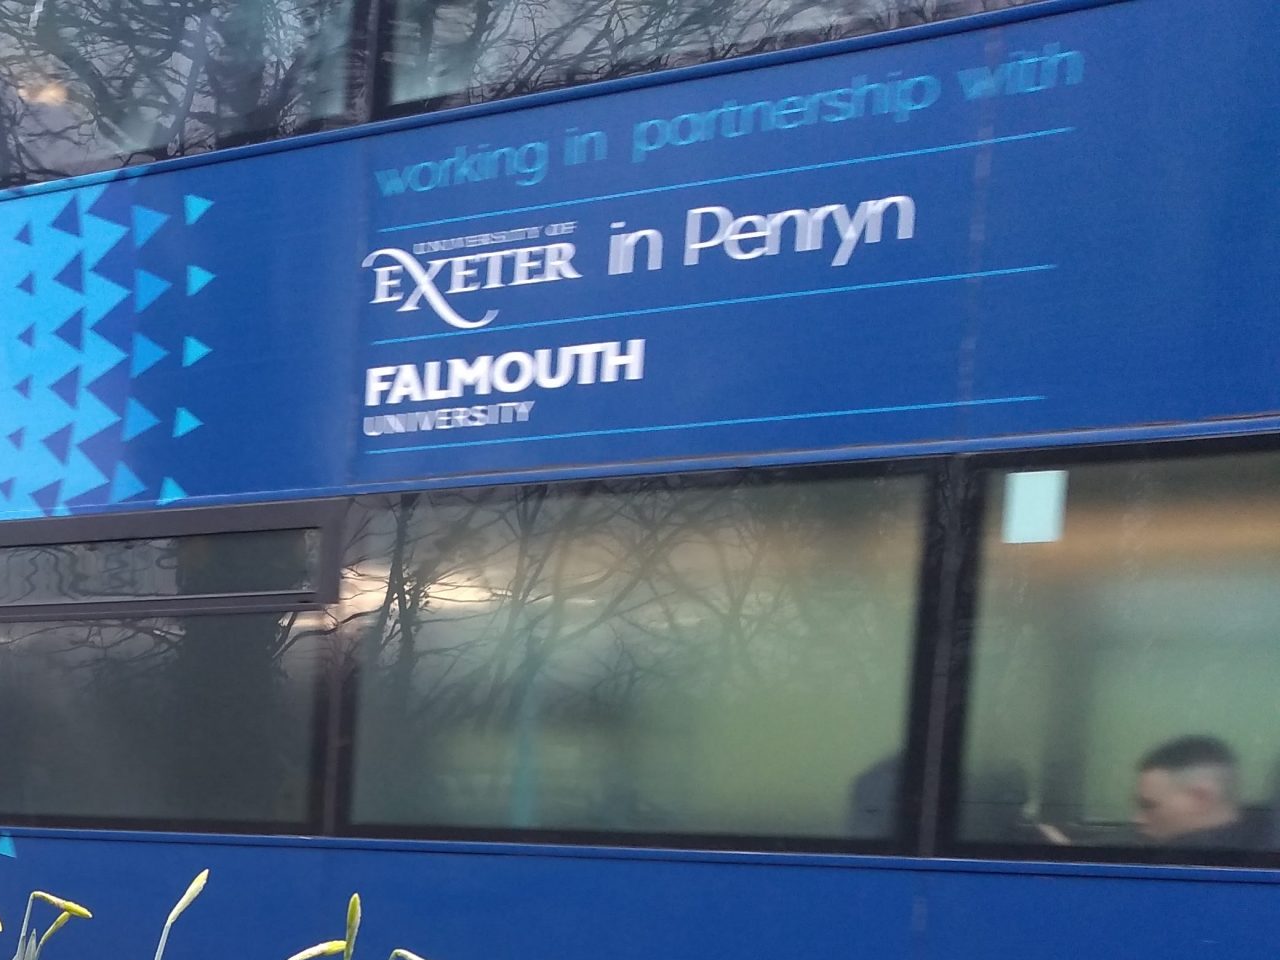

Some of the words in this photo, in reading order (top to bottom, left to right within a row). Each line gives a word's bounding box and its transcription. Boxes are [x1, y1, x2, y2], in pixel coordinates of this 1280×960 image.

[375, 140, 549, 197] working
[563, 126, 608, 165] in
[632, 70, 940, 163] partnership
[956, 42, 1086, 101] with
[361, 242, 583, 328] EXETER
[608, 221, 664, 276] in
[683, 194, 917, 267] Penryn
[413, 225, 542, 254] UNIVERSITY
[365, 338, 646, 406] FALMOUTH
[363, 400, 536, 436] UNIVERSITY
